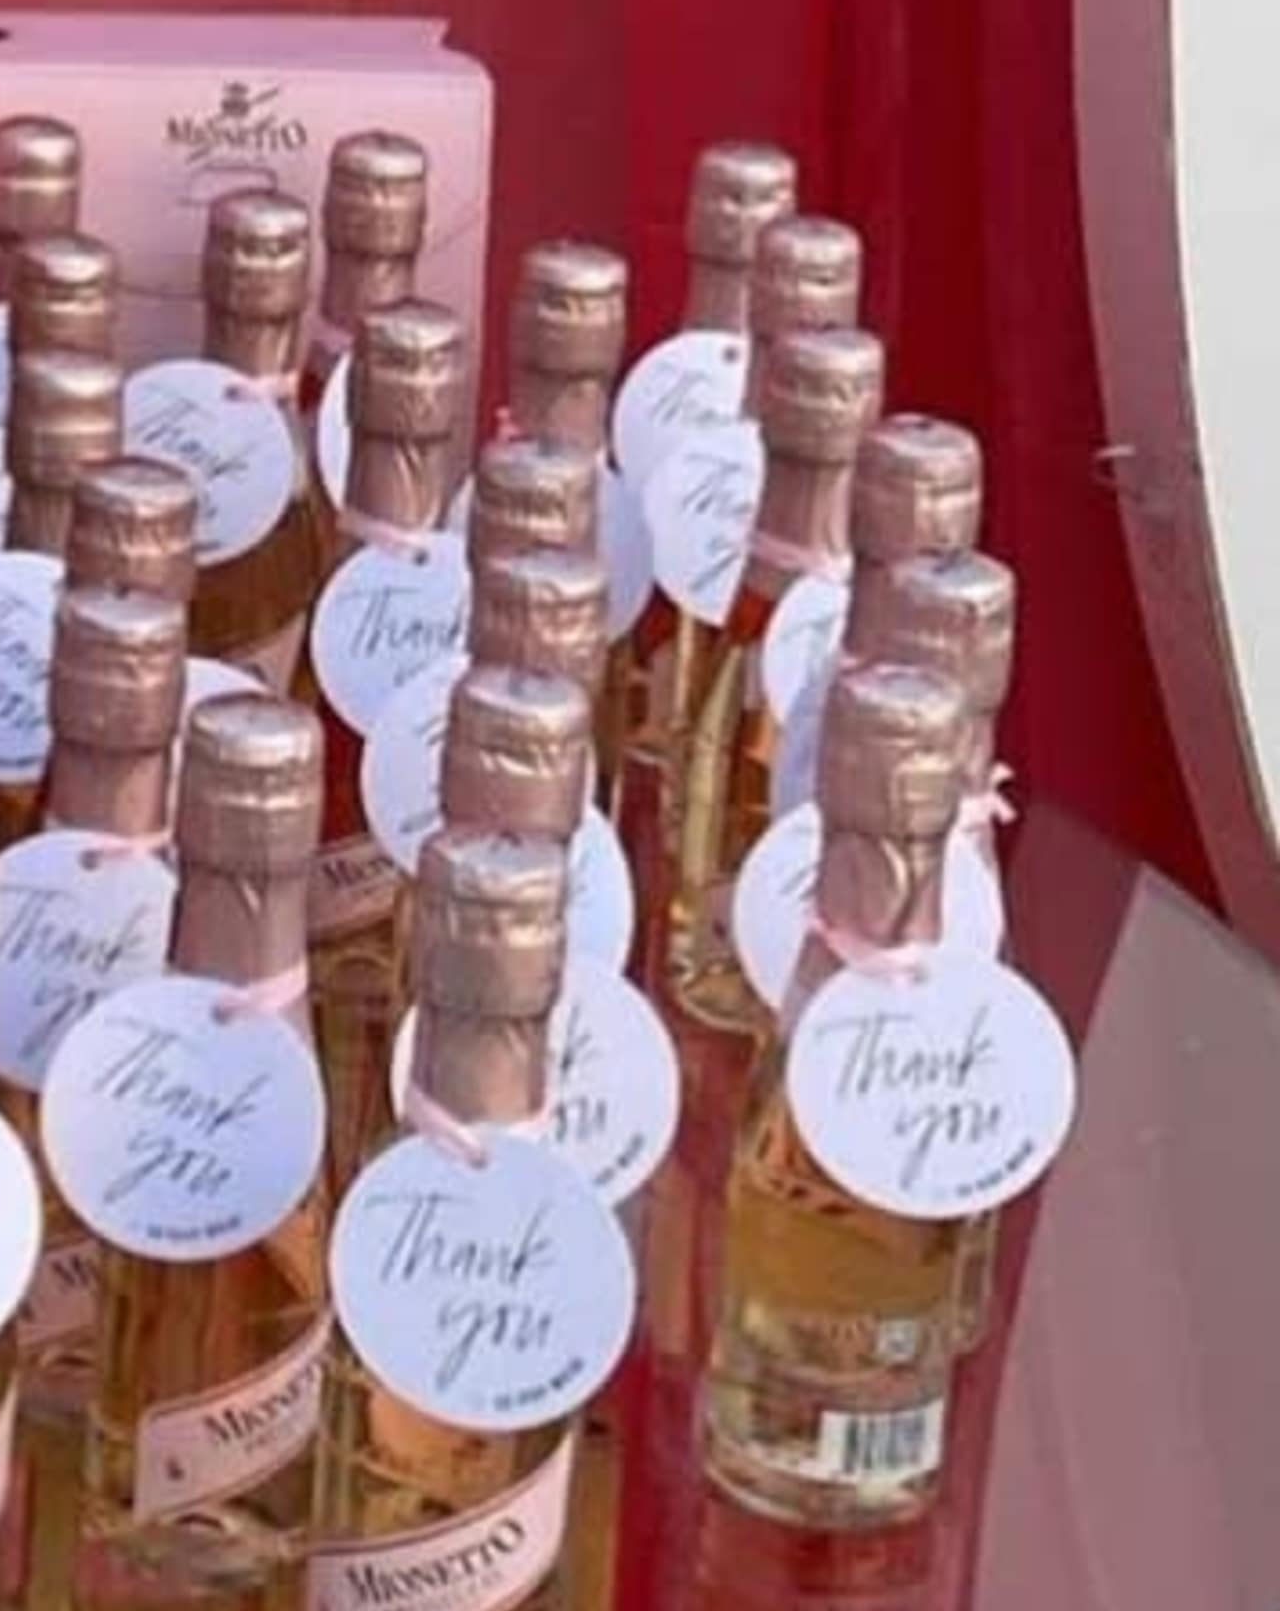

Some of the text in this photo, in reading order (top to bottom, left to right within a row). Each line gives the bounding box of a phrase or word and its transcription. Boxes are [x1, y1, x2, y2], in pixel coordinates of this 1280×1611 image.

[96, 1017, 272, 1139] Thank
[810, 1007, 998, 1107] Thank
[104, 1129, 233, 1204] you
[894, 1100, 1002, 1194] you
[364, 1192, 560, 1287] Thank
[437, 1298, 553, 1393] you
[345, 1517, 525, 1608] MIONETTO
